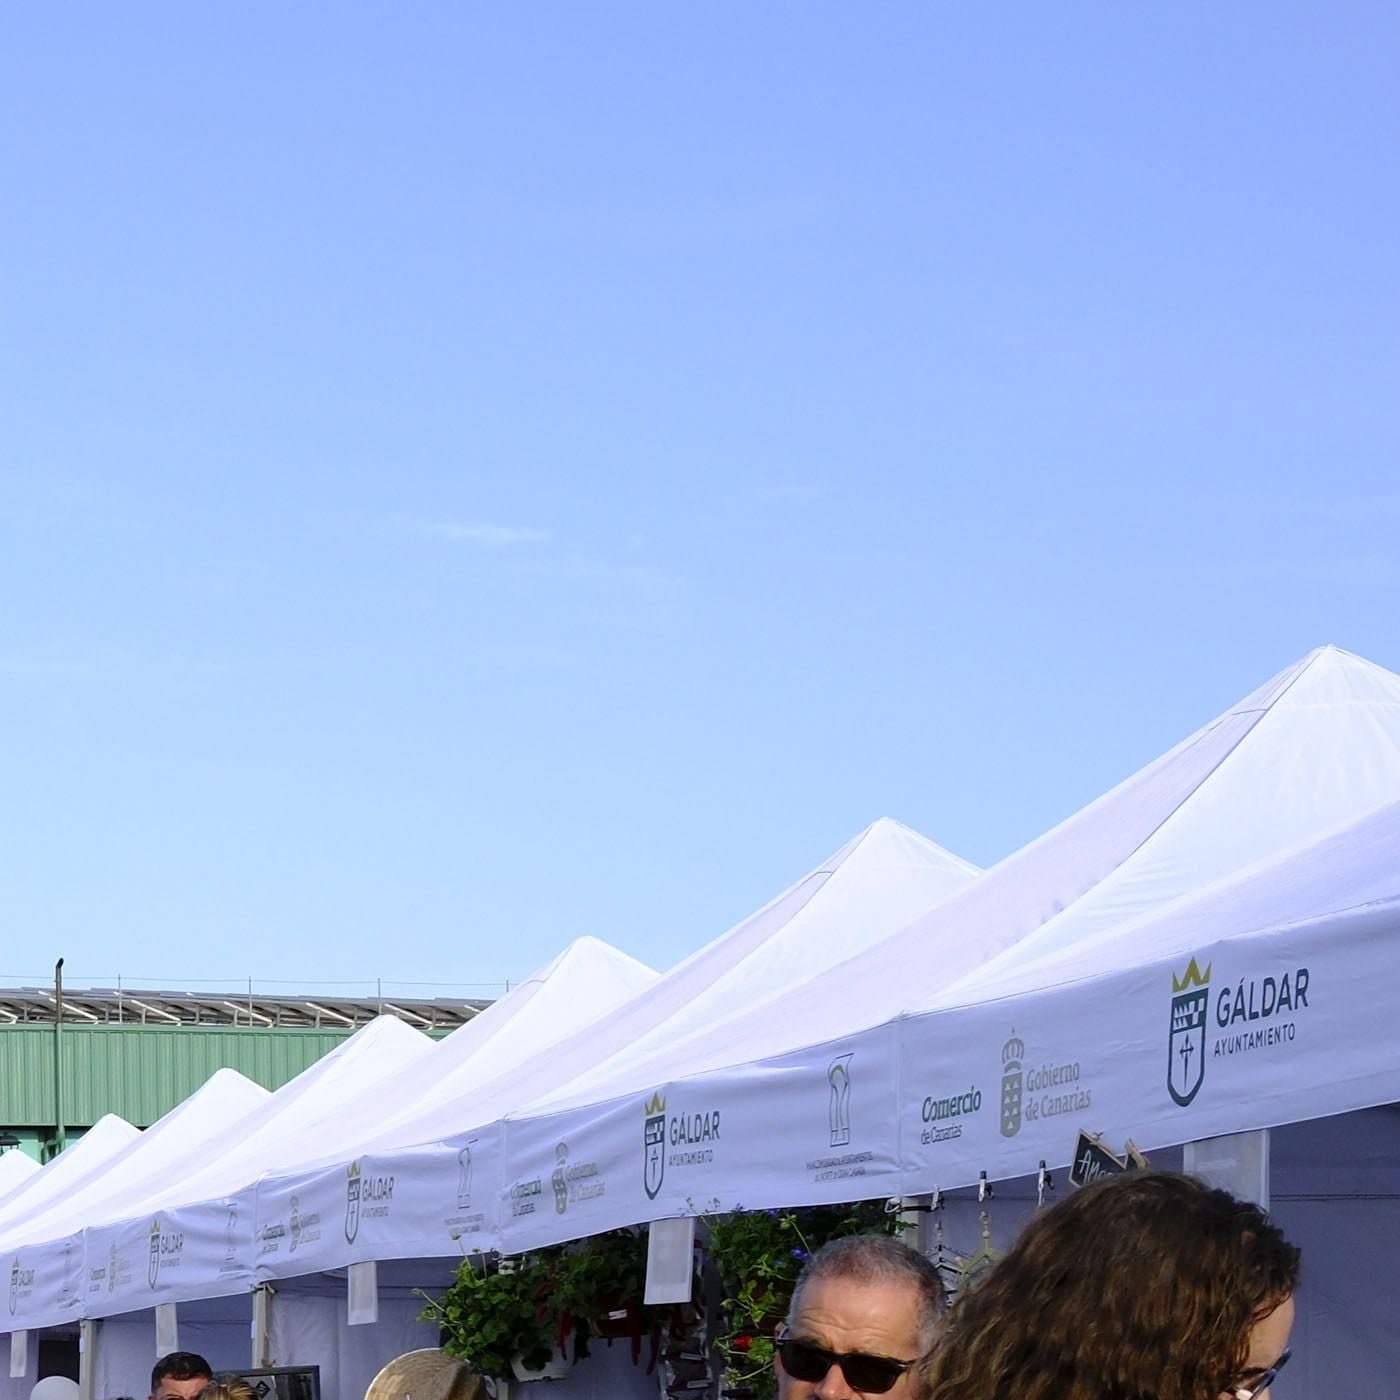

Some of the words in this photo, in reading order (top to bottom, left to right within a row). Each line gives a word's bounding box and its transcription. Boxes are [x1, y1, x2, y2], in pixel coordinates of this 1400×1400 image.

[1216, 968, 1309, 1028] GÁLDAR
[1214, 1023, 1296, 1057] AYUNTAMIENTO
[1026, 1062, 1081, 1092] Gobierno
[922, 1086, 982, 1123] Comercio
[1025, 1097, 1039, 1122] de
[1041, 1087, 1092, 1118] Canarias
[670, 1111, 721, 1146] GÁLDAR
